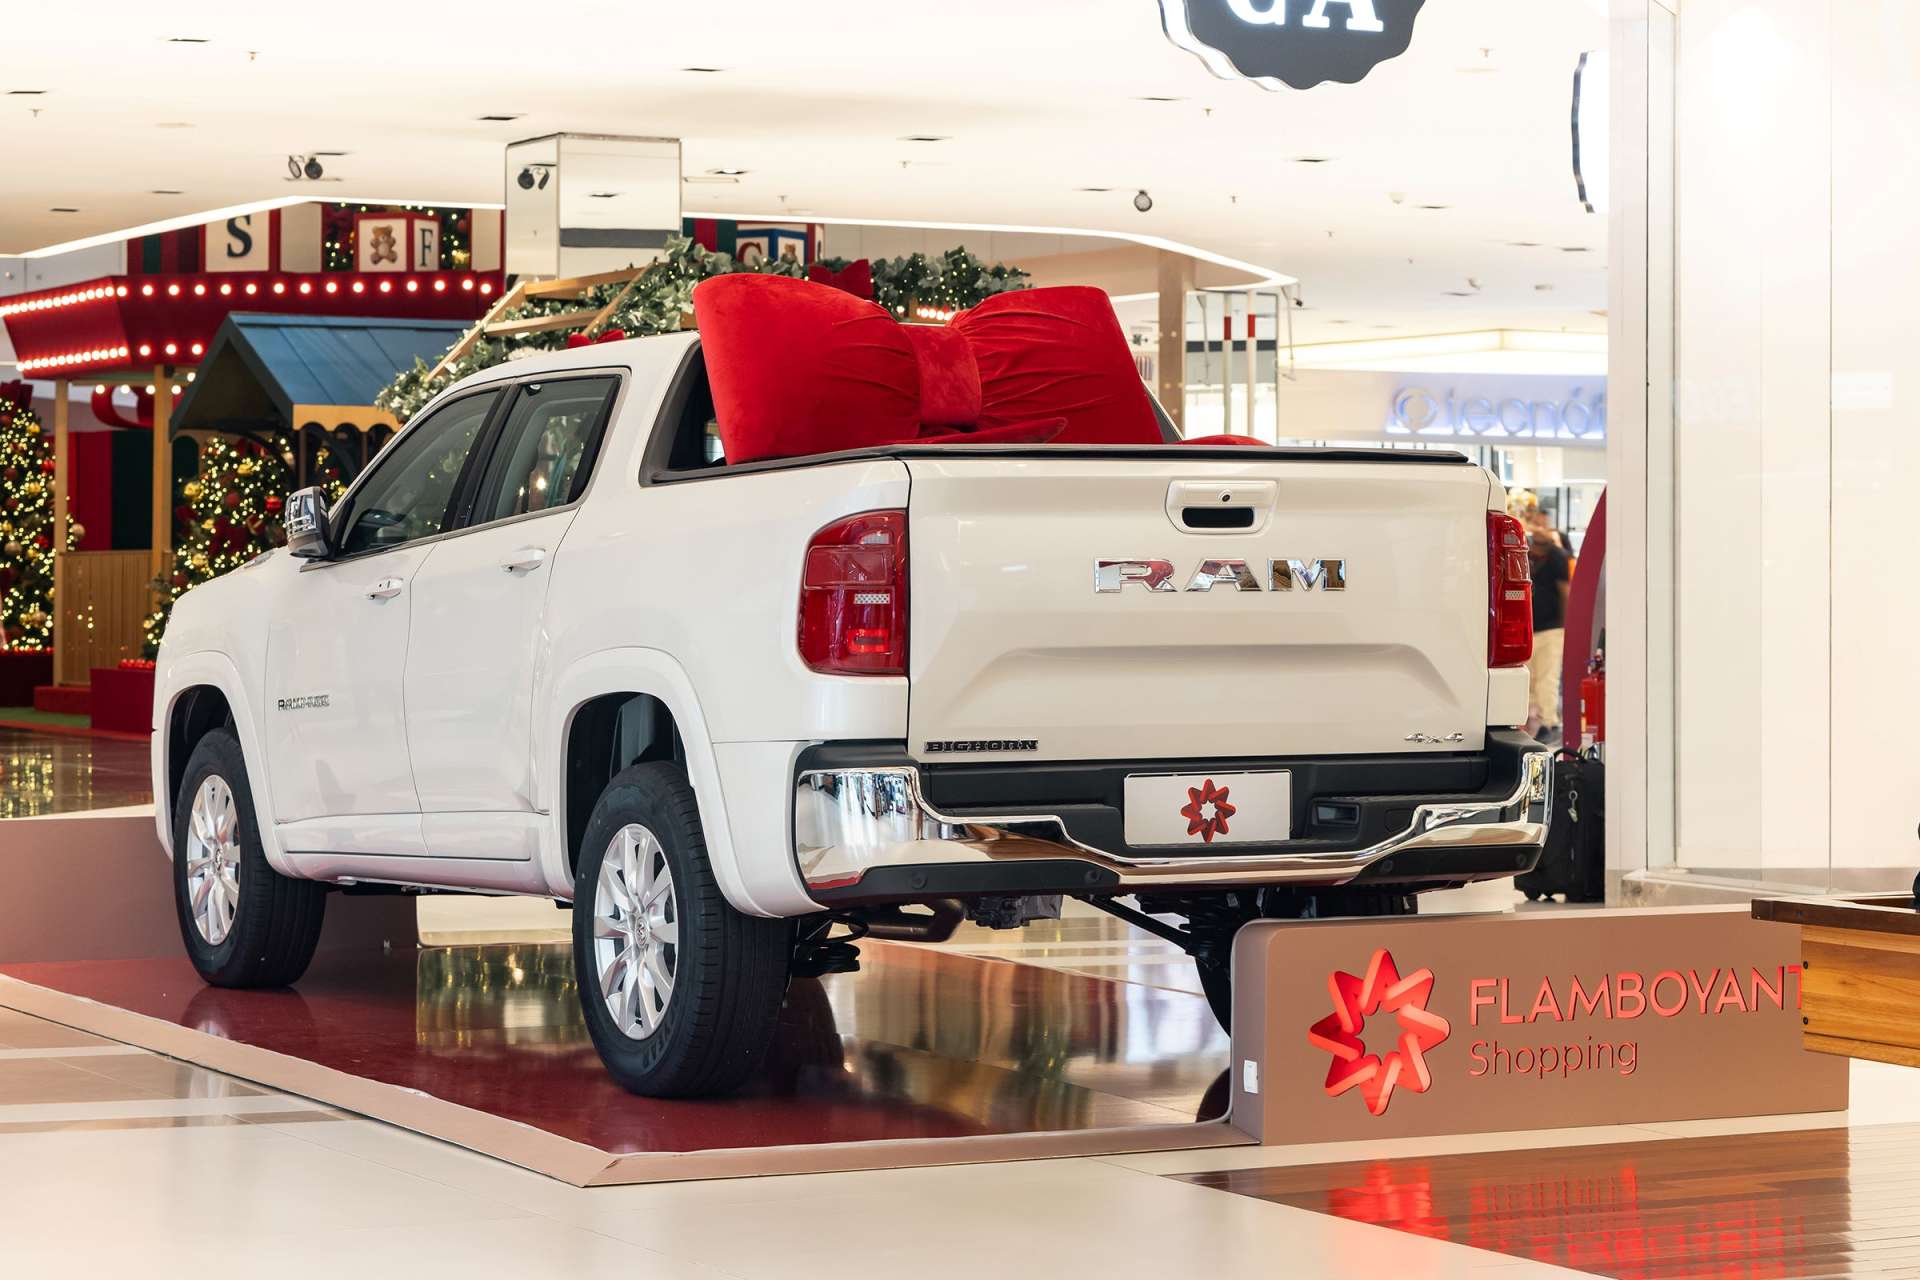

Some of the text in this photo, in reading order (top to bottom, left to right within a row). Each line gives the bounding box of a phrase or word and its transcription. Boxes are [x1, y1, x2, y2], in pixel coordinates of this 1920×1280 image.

[419, 228, 434, 267] F
[1094, 559, 1346, 592] RAM
[924, 740, 1038, 753] BIGHORN
[1470, 965, 1802, 1026] FLAMBOYANT
[1469, 1036, 1638, 1079] Shopping
